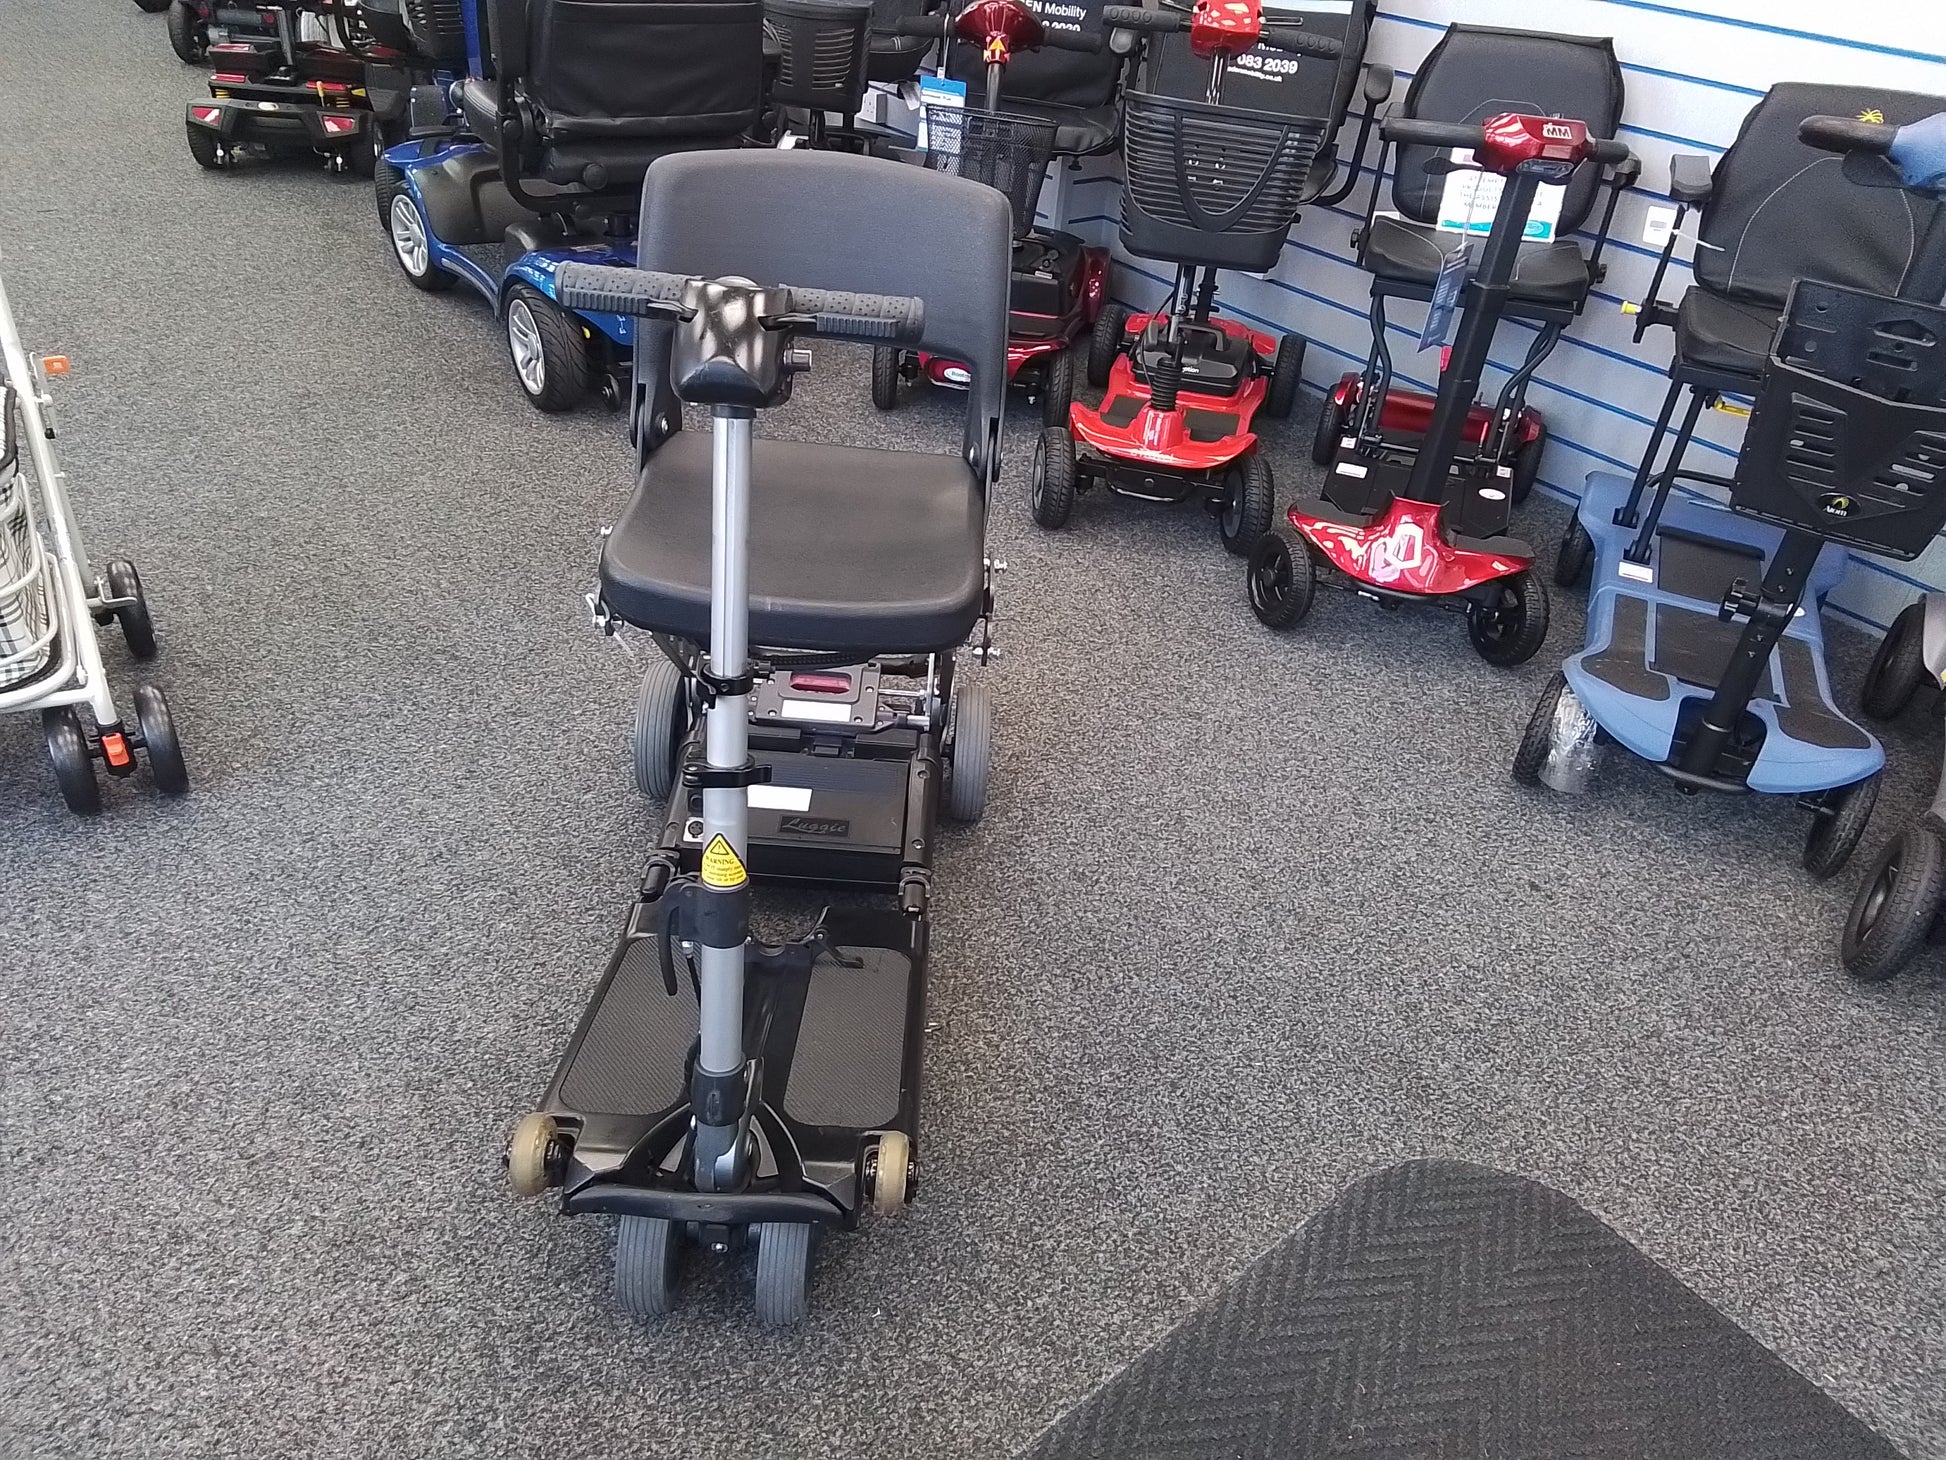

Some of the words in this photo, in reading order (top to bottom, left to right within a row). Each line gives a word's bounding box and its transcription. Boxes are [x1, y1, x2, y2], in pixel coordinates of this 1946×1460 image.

[1044, 2, 1087, 20] Mobility
[1263, 58, 1298, 74] 2039
[782, 818, 846, 834] Luggie
